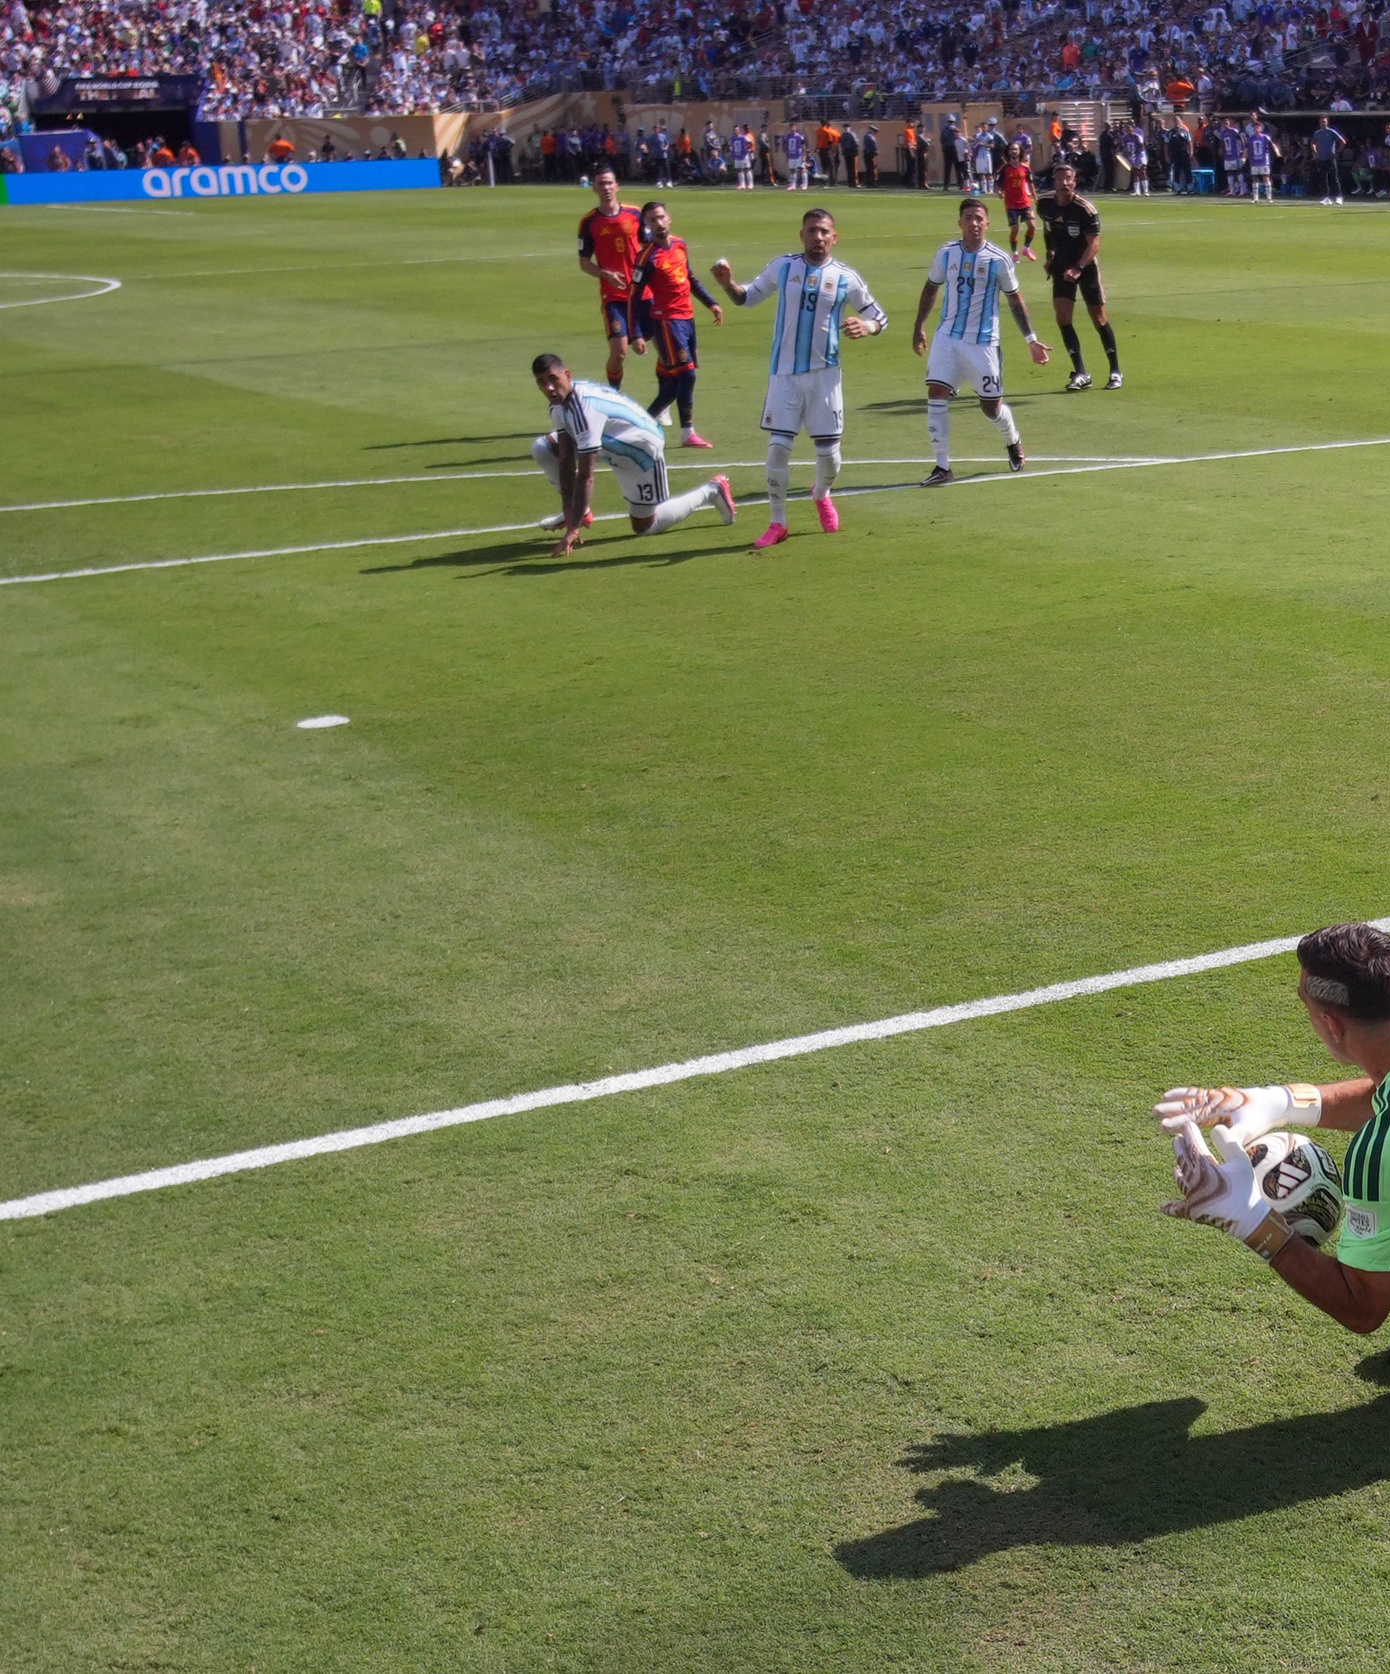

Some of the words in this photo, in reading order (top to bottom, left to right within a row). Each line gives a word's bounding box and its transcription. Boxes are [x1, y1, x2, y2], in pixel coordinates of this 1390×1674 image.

[142, 164, 309, 198] aramco
[957, 276, 975, 294] 24
[982, 376, 999, 393] 24
[637, 483, 654, 501] 13
